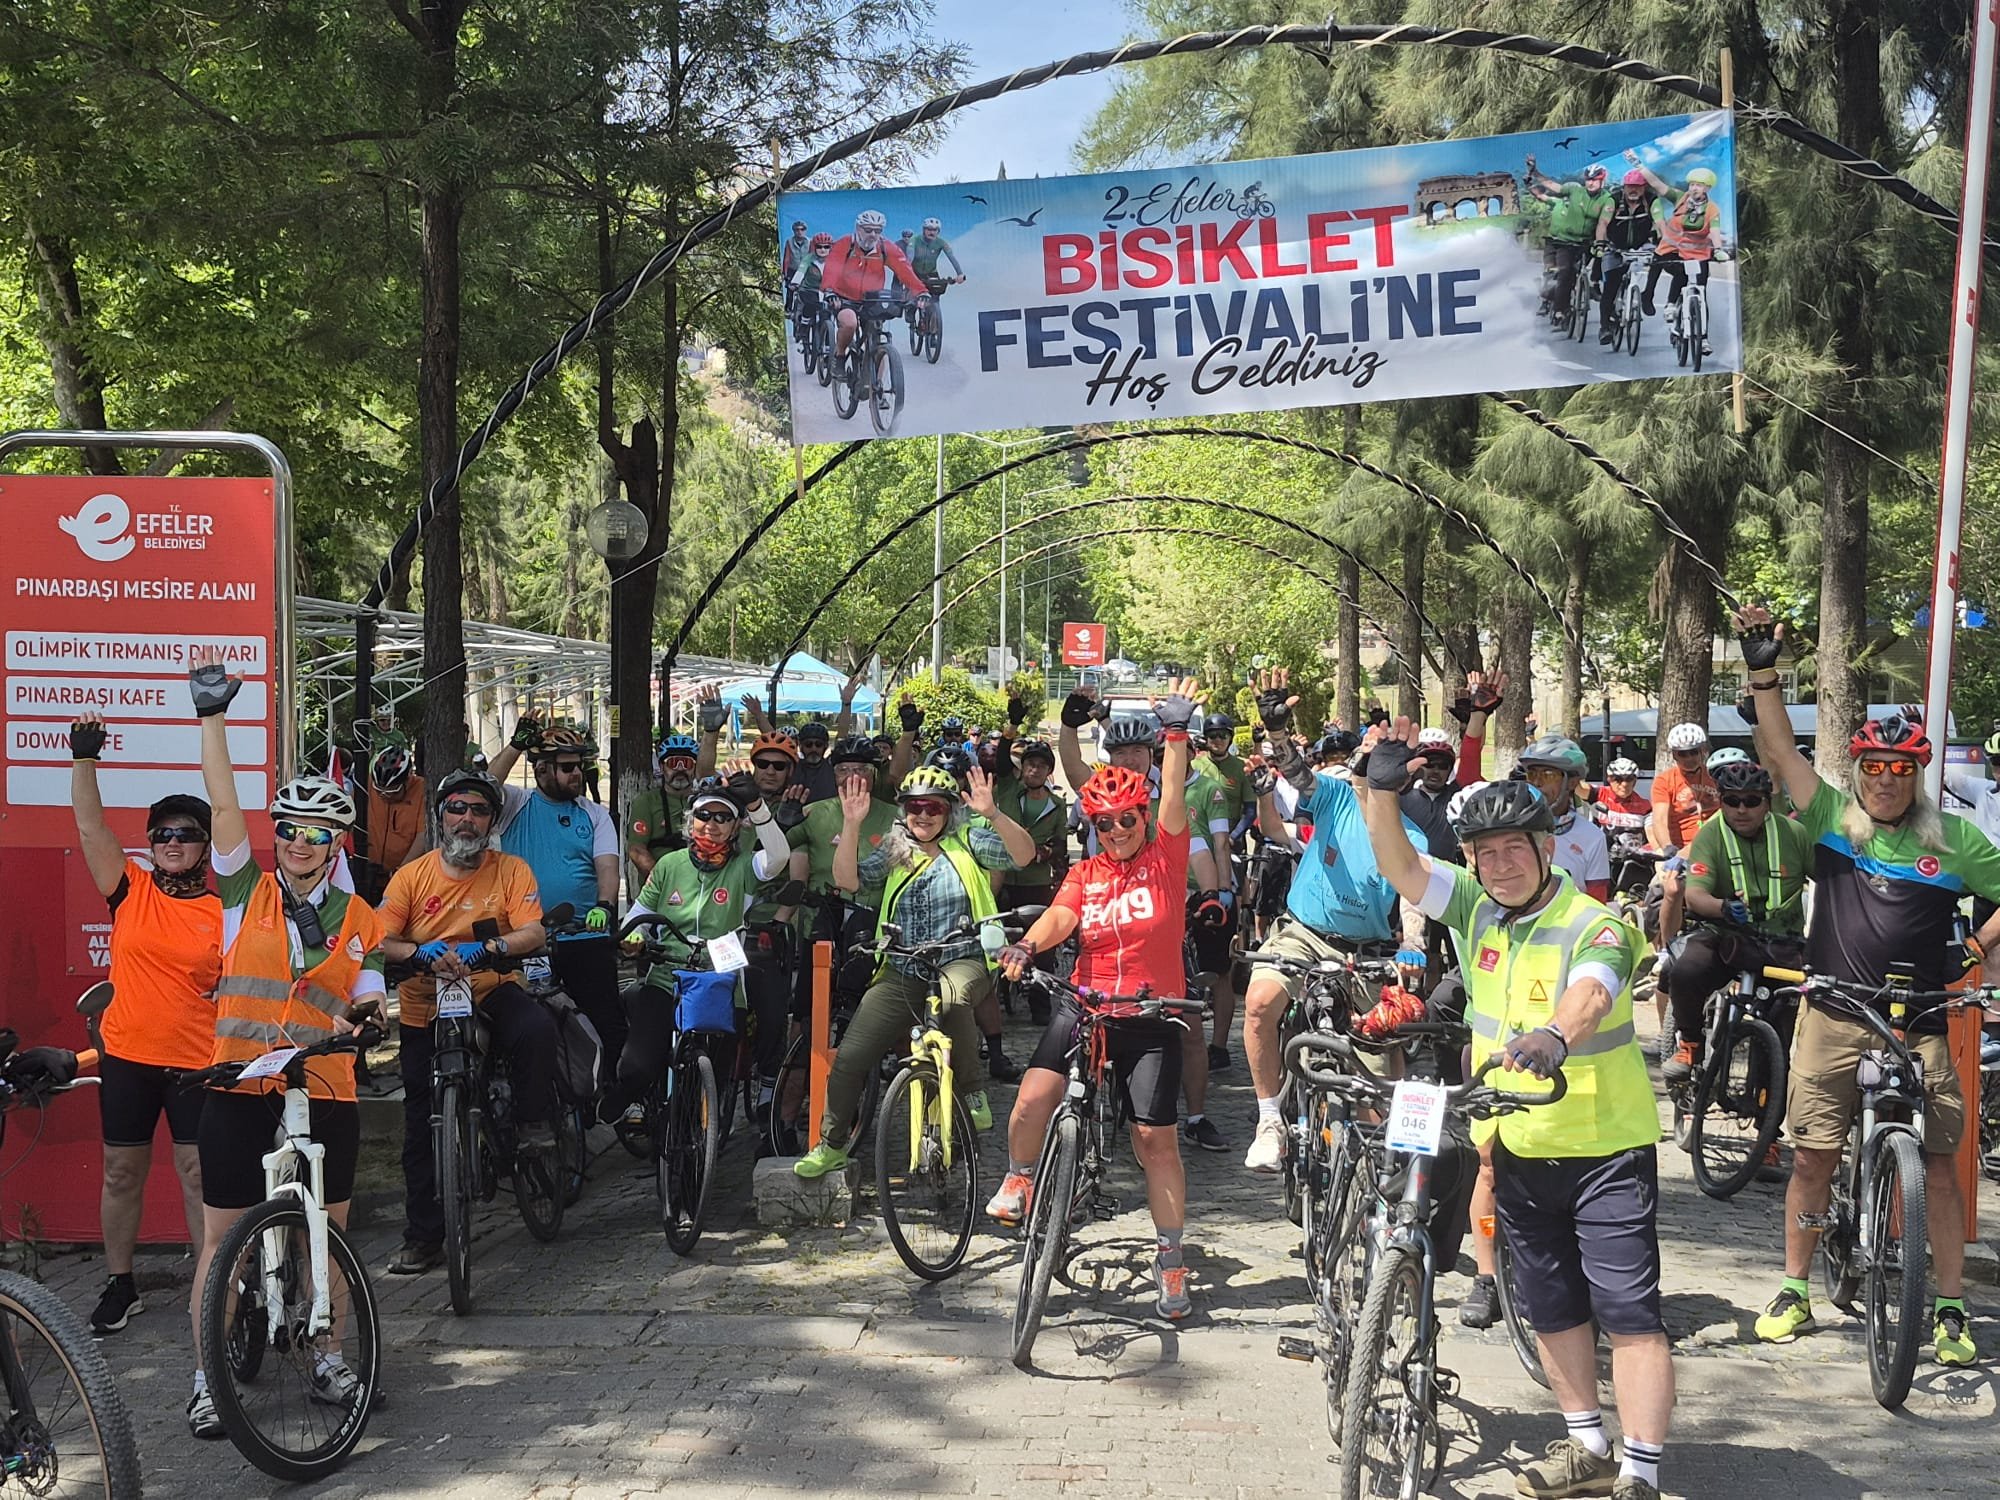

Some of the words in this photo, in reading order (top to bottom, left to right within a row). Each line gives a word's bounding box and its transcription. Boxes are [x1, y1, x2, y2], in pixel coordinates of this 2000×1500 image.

[1086, 346, 1171, 411] Hoş
[1191, 334, 1388, 396] Geldiniz
[136, 513, 214, 535] EFELER
[144, 536, 206, 550] BELEDİYESİ
[16, 577, 118, 602] PINARBAŞI
[123, 577, 195, 600] MESİRE
[199, 582, 256, 601] ALANI
[15, 636, 91, 659] OLİMPİK
[95, 641, 184, 665] TIRMANIŞ
[16, 685, 113, 709] PINARBAŞI
[119, 689, 166, 706] KAFE
[444, 992, 463, 1002] 038
[1401, 1116, 1427, 1131] 046
